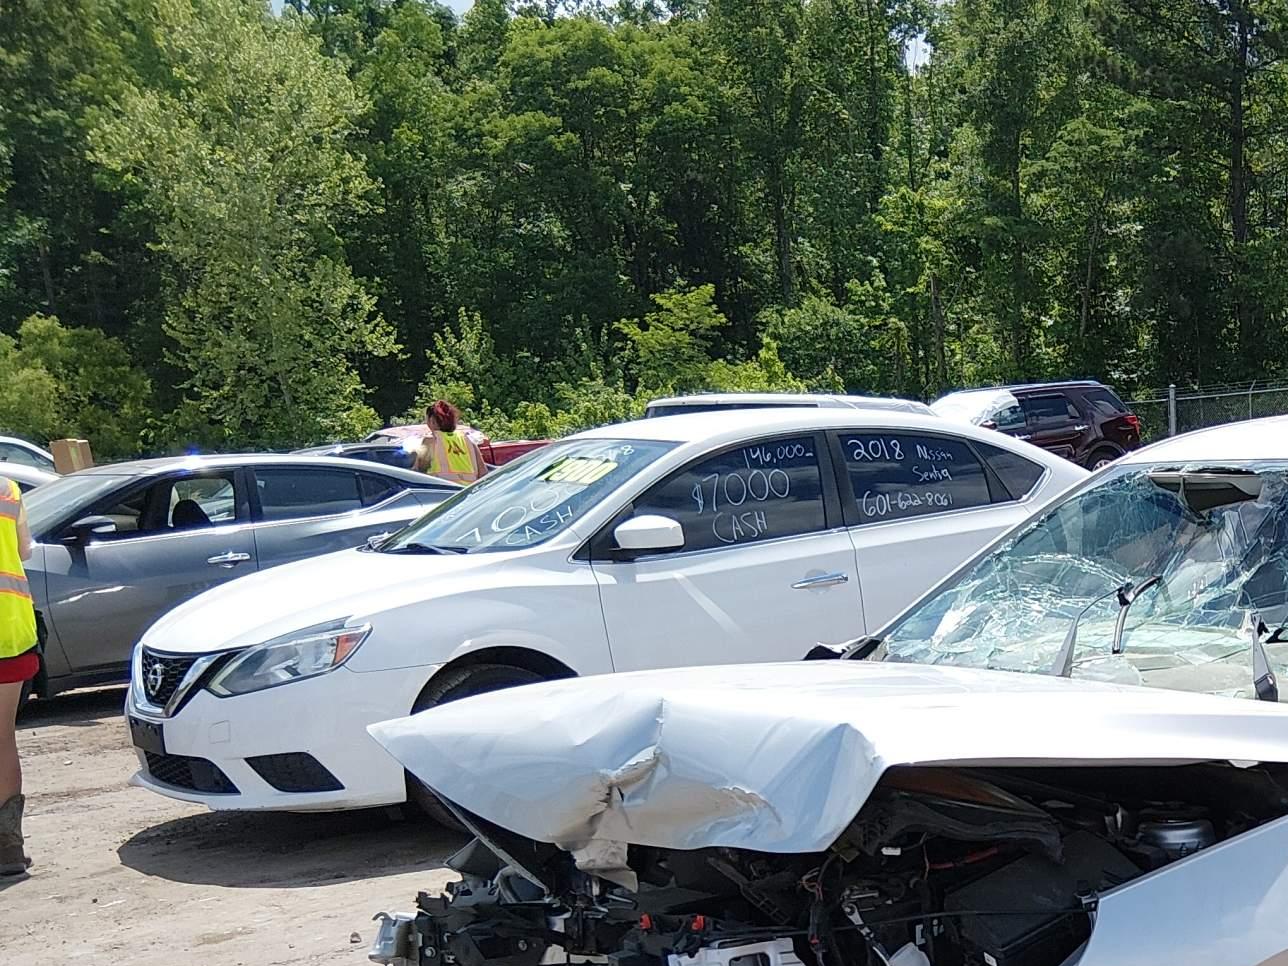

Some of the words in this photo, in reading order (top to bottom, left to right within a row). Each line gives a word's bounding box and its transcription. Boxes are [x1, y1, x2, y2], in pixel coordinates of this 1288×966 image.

[847, 439, 905, 460] 2018
[691, 468, 790, 514] $7000
[506, 506, 573, 544] CASH
[712, 511, 768, 543] CASH
